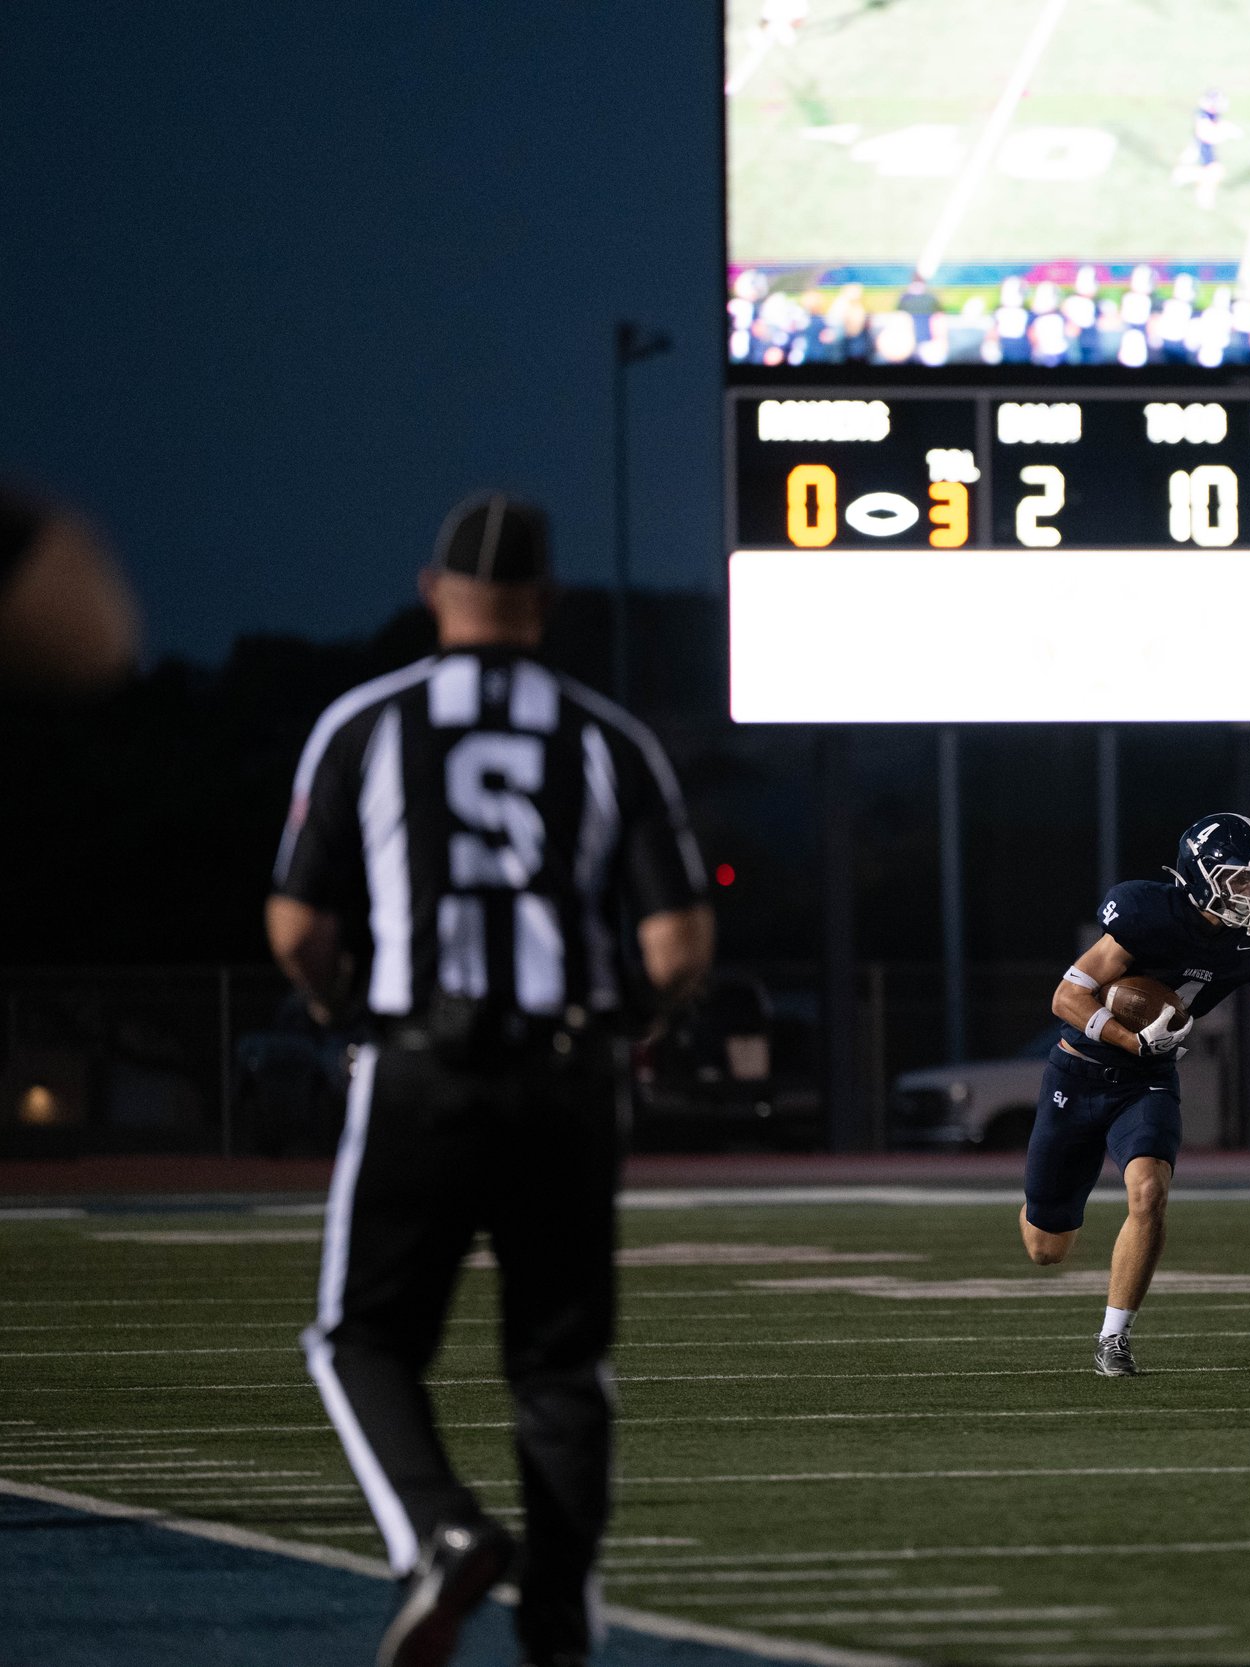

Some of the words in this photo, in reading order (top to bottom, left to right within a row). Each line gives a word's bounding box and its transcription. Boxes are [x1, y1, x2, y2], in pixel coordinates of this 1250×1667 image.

[787, 464, 837, 548] 0
[928, 481, 969, 548] 3
[1016, 465, 1065, 547] 2
[1169, 465, 1239, 547] 10
[445, 731, 547, 889] S
[1194, 822, 1220, 850] 4
[1102, 900, 1119, 926] SV
[1182, 967, 1214, 982] RANGERS
[1053, 1091, 1069, 1108] SV
